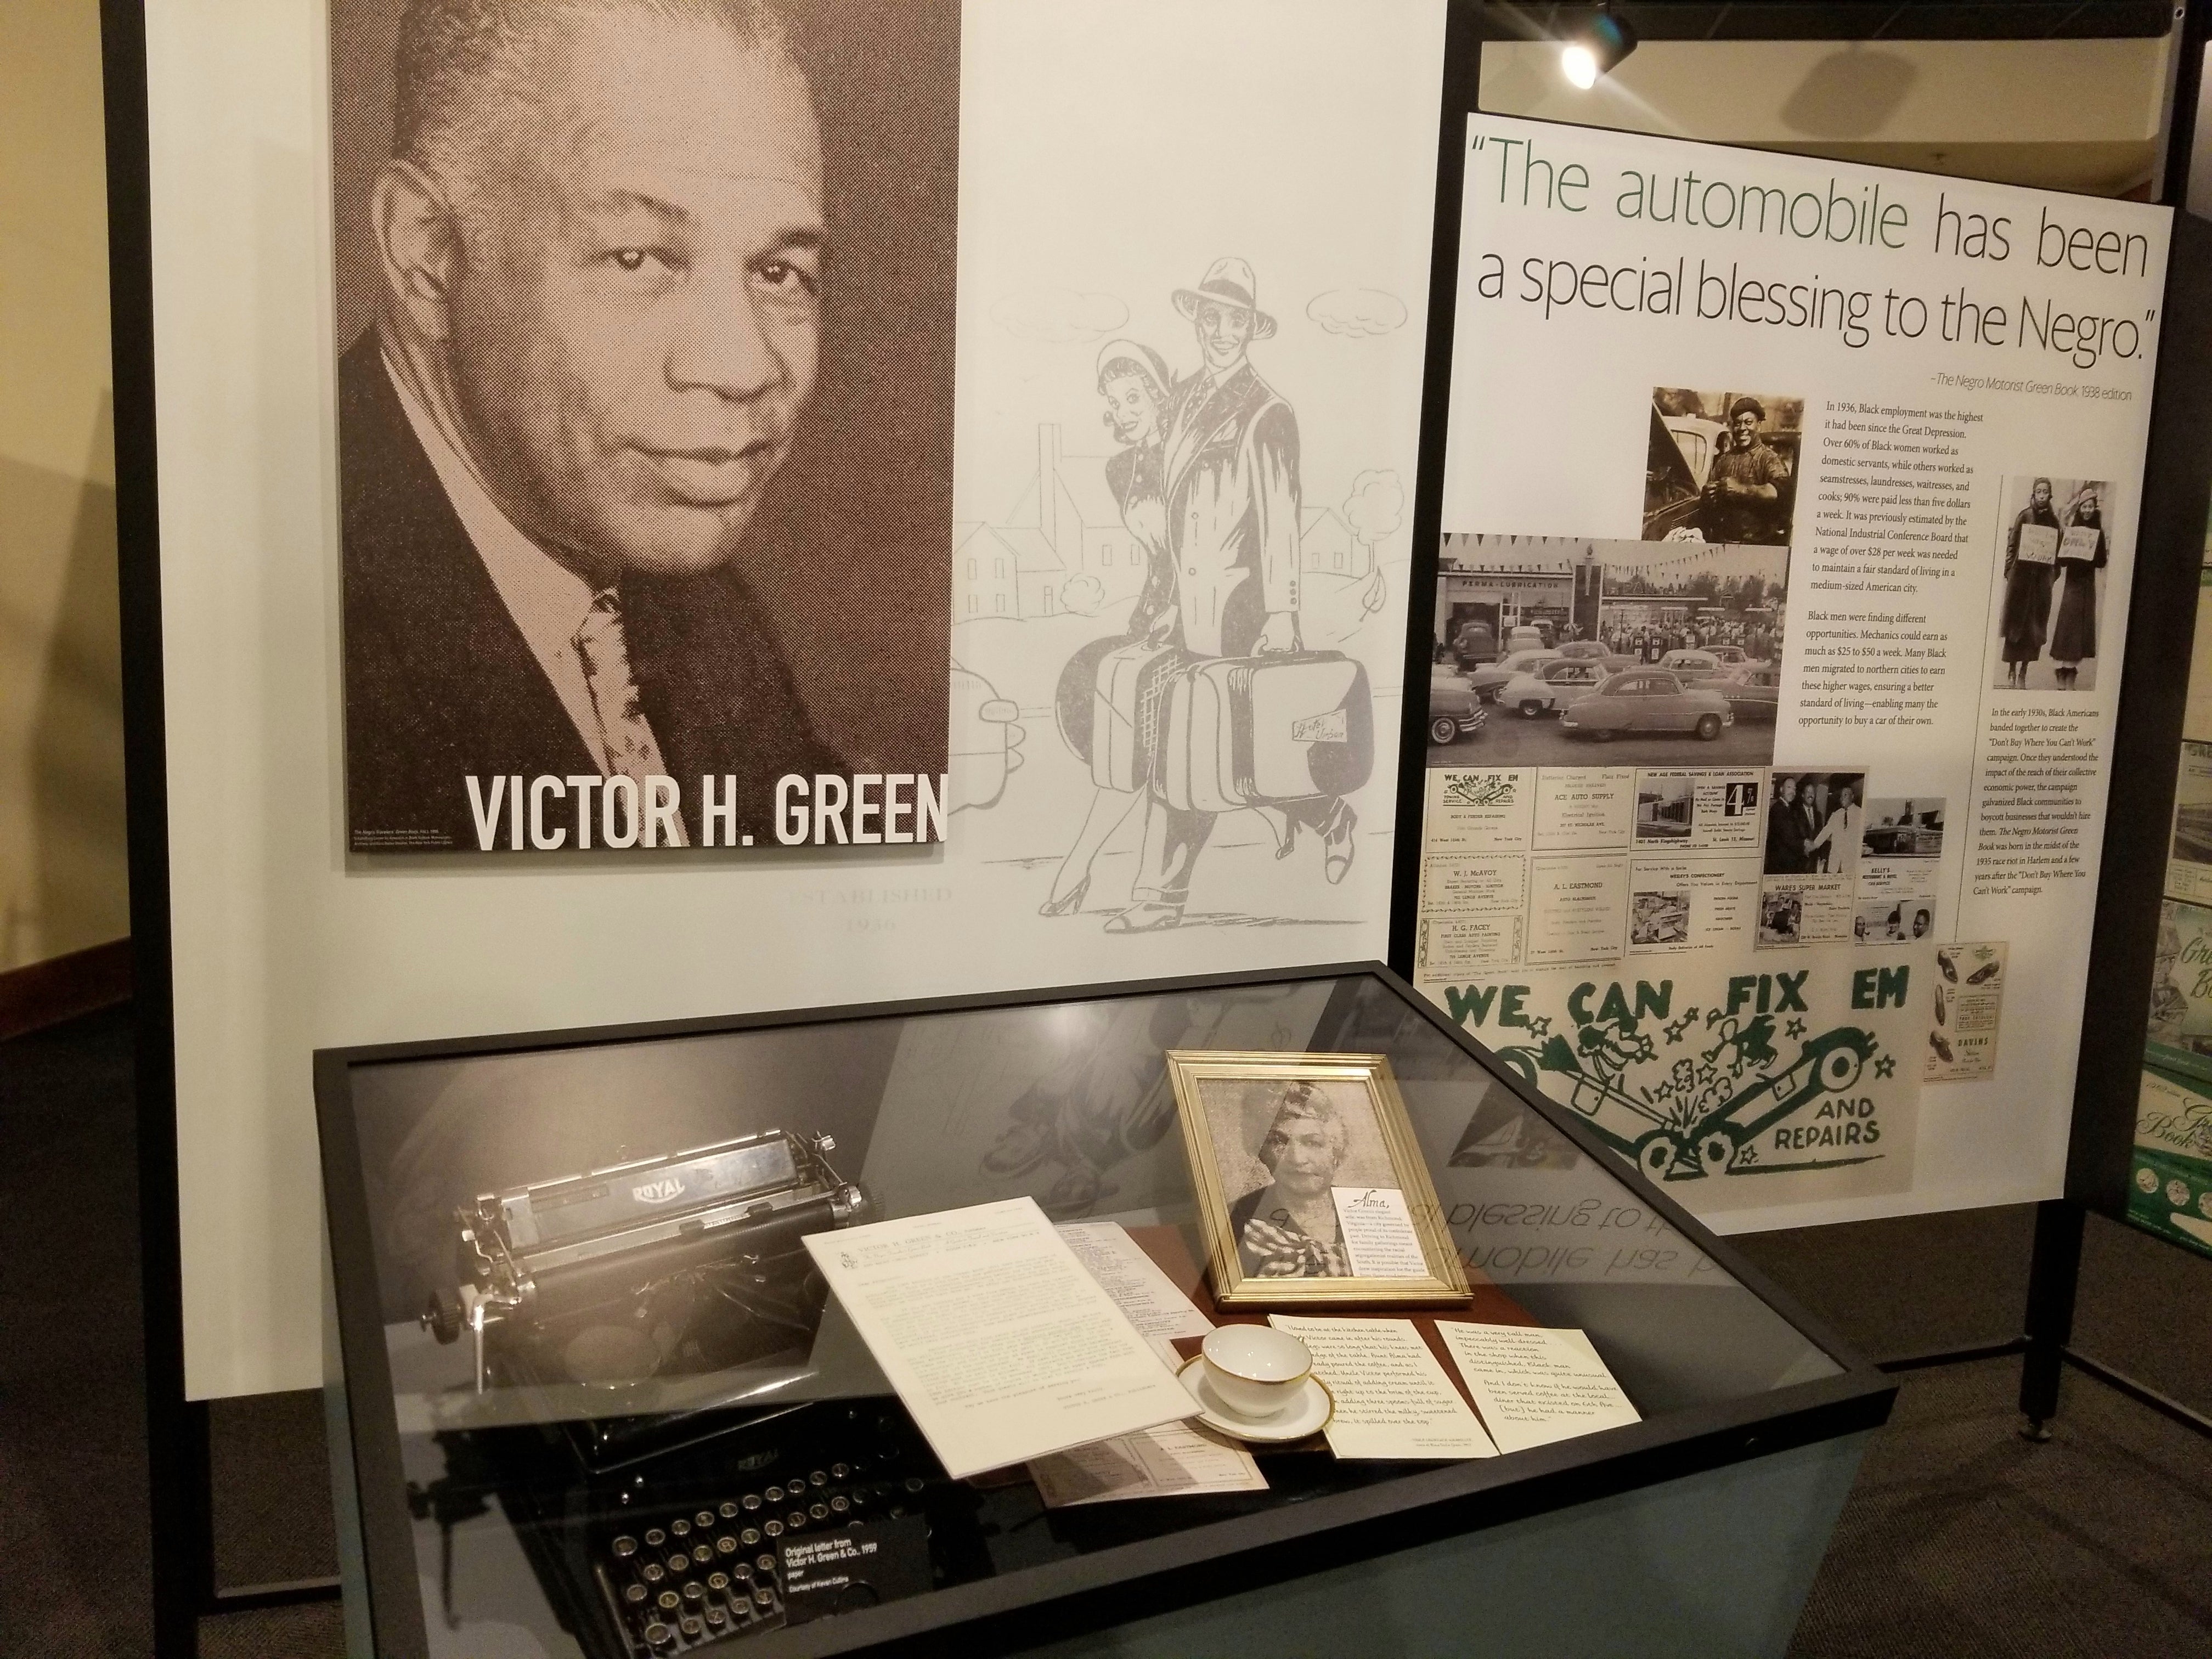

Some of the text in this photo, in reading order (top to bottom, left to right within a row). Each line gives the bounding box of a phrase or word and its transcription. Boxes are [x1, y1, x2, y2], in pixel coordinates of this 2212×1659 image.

[1615, 168, 1908, 250] automobile
[1933, 192, 2011, 261] has
[2036, 207, 2148, 277] been
[1477, 254, 1504, 300] a
[1520, 255, 1681, 320] special
[1696, 259, 1871, 347] blessing
[1885, 290, 1928, 337] to
[1941, 286, 2006, 346] the
[1955, 374, 1984, 391] Negro
[1985, 377, 2024, 392] Motorist
[2025, 380, 2053, 394] Green
[2054, 383, 2079, 397] Book
[2081, 386, 2100, 399] 1938
[2101, 387, 2132, 400] edition
[1826, 400, 1835, 411] In
[1837, 402, 1857, 414] 1936,
[1858, 403, 1880, 414] Black
[1881, 406, 1927, 419] employment
[1944, 409, 1956, 420] the
[1957, 410, 1983, 424] highest
[1825, 419, 1966, 439] it had been since the Great Depression.
[1823, 437, 1843, 448] Over
[1844, 439, 1860, 449] 60%
[1861, 439, 1871, 449] of
[1871, 440, 1892, 451] Black
[1893, 444, 1920, 453] women
[1922, 444, 1950, 455] worked
[1807, 610, 1829, 620] Black
[1867, 612, 1894, 625] finding
[1895, 613, 1926, 623] different
[1806, 629, 1858, 641] opportunities.
[1860, 629, 1899, 640] Mechanics
[1900, 630, 1921, 640] could
[1798, 715, 1844, 727] opportunity
[1854, 715, 1869, 727] buy
[1888, 715, 1898, 725] of
[1897, 715, 1915, 725] their
[1991, 708, 1999, 716] In
[2000, 708, 2010, 716] the
[2011, 708, 2027, 719] early
[2048, 708, 2065, 718] Black
[2066, 709, 2099, 717] Americans
[2010, 738, 2023, 749] Buy
[2024, 738, 2045, 747] Where
[465, 772, 947, 851] VICTOR H. GREEN
[1444, 965, 1910, 1029] WE CAN FIX EM
[1815, 1098, 1875, 1120] AND
[1775, 1121, 1881, 1150] REPAIRS
[633, 1178, 685, 1201] ROYAL
[1347, 1189, 1390, 1209] Alma,
[785, 1544, 814, 1557] Original
